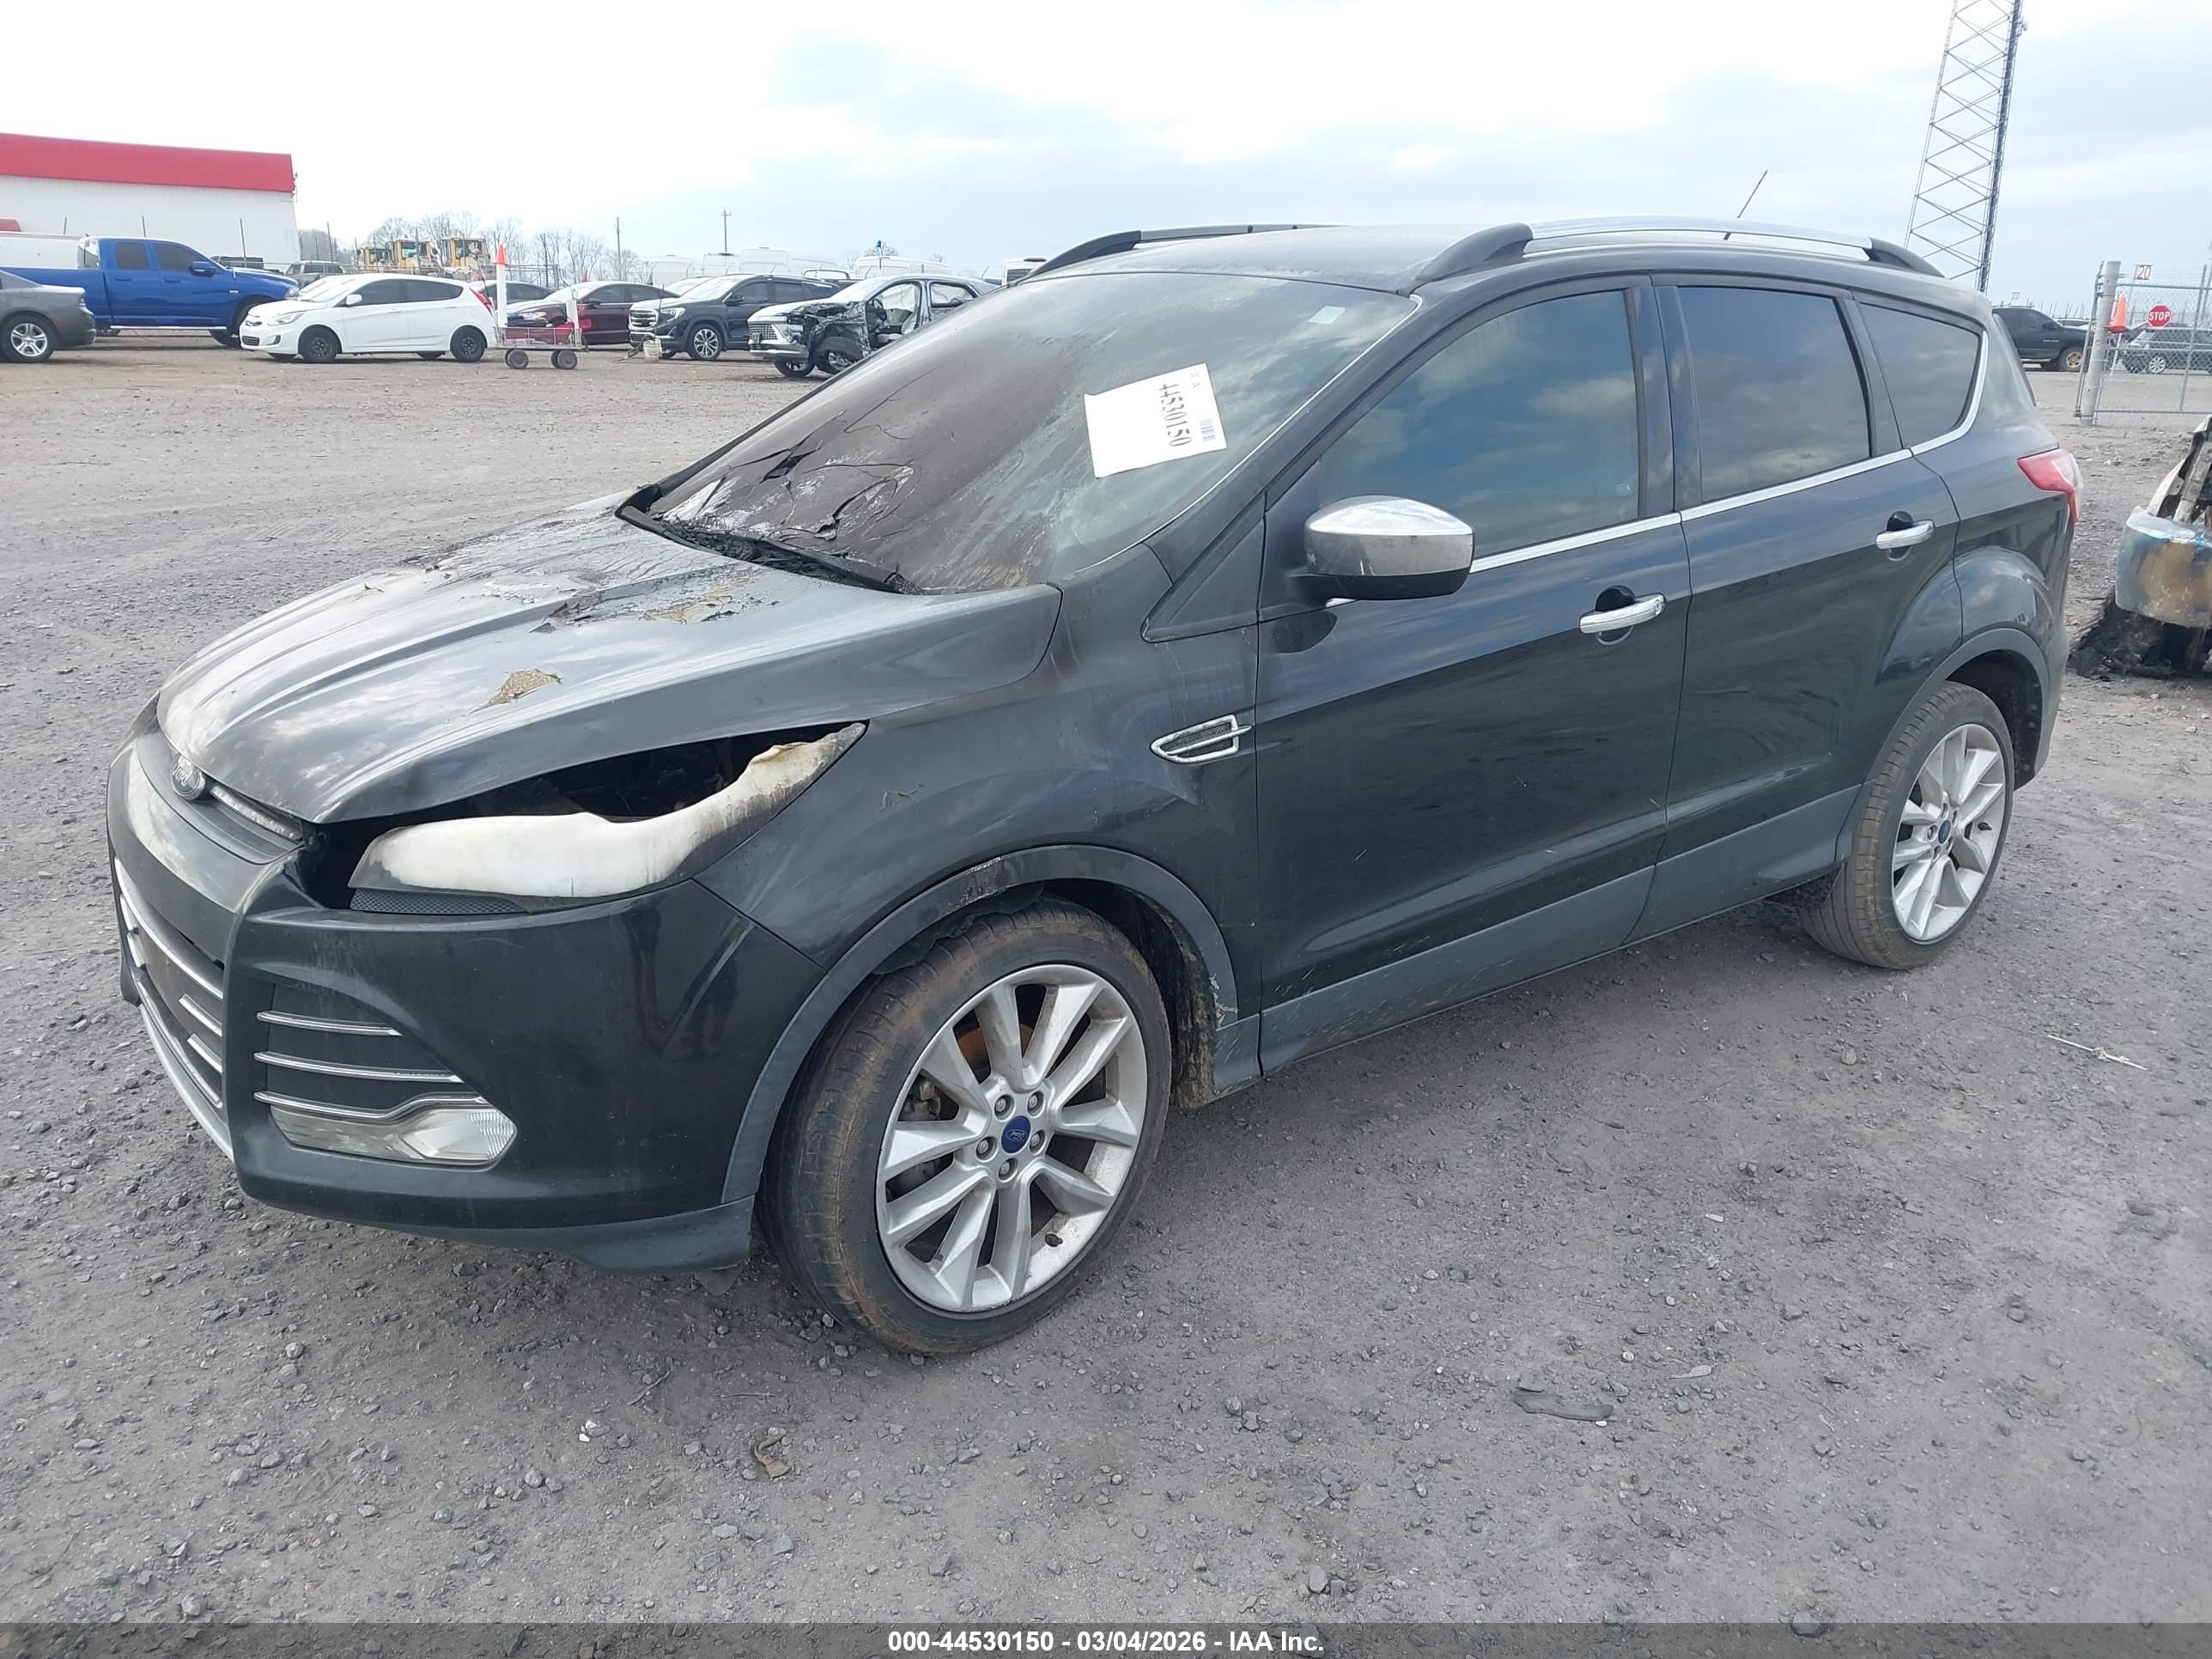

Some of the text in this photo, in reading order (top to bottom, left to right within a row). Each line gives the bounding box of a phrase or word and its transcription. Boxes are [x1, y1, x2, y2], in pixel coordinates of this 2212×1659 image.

[2137, 264, 2151, 280] 20
[2148, 311, 2170, 321] STOP
[1158, 383, 1193, 447] 44530150
